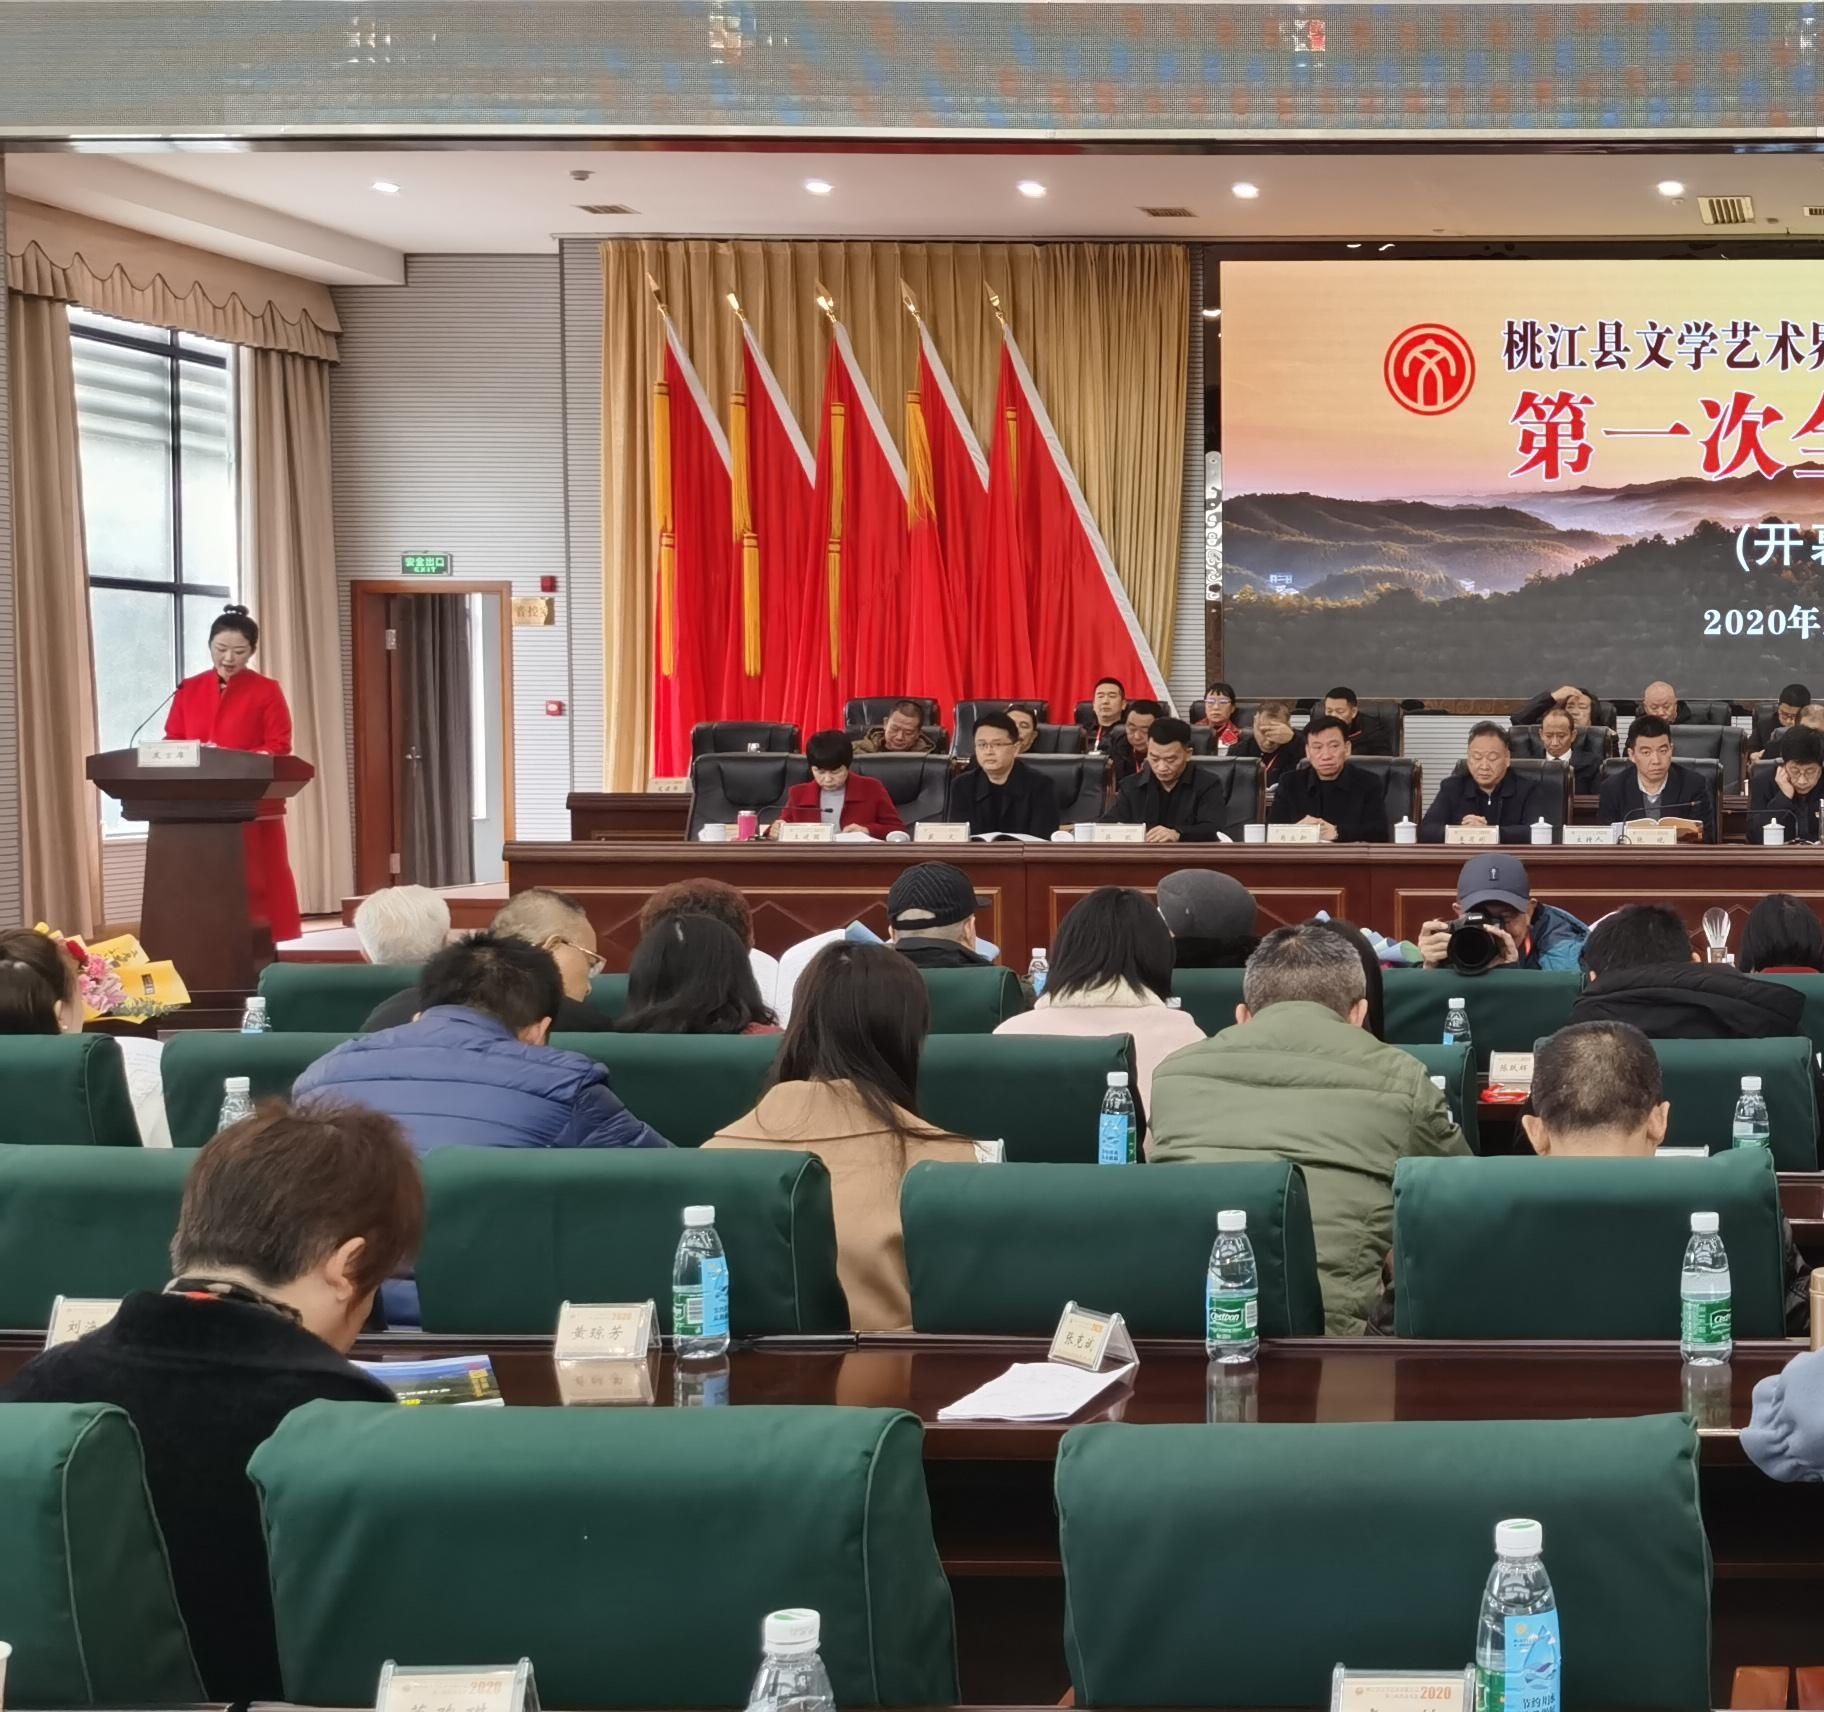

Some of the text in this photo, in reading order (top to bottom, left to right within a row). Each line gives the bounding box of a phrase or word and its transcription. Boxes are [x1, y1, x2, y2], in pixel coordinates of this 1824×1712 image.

[405, 557, 445, 567] 安全出口
[469, 1680, 503, 1695] 2020
[1420, 1686, 1452, 1700] 2020
